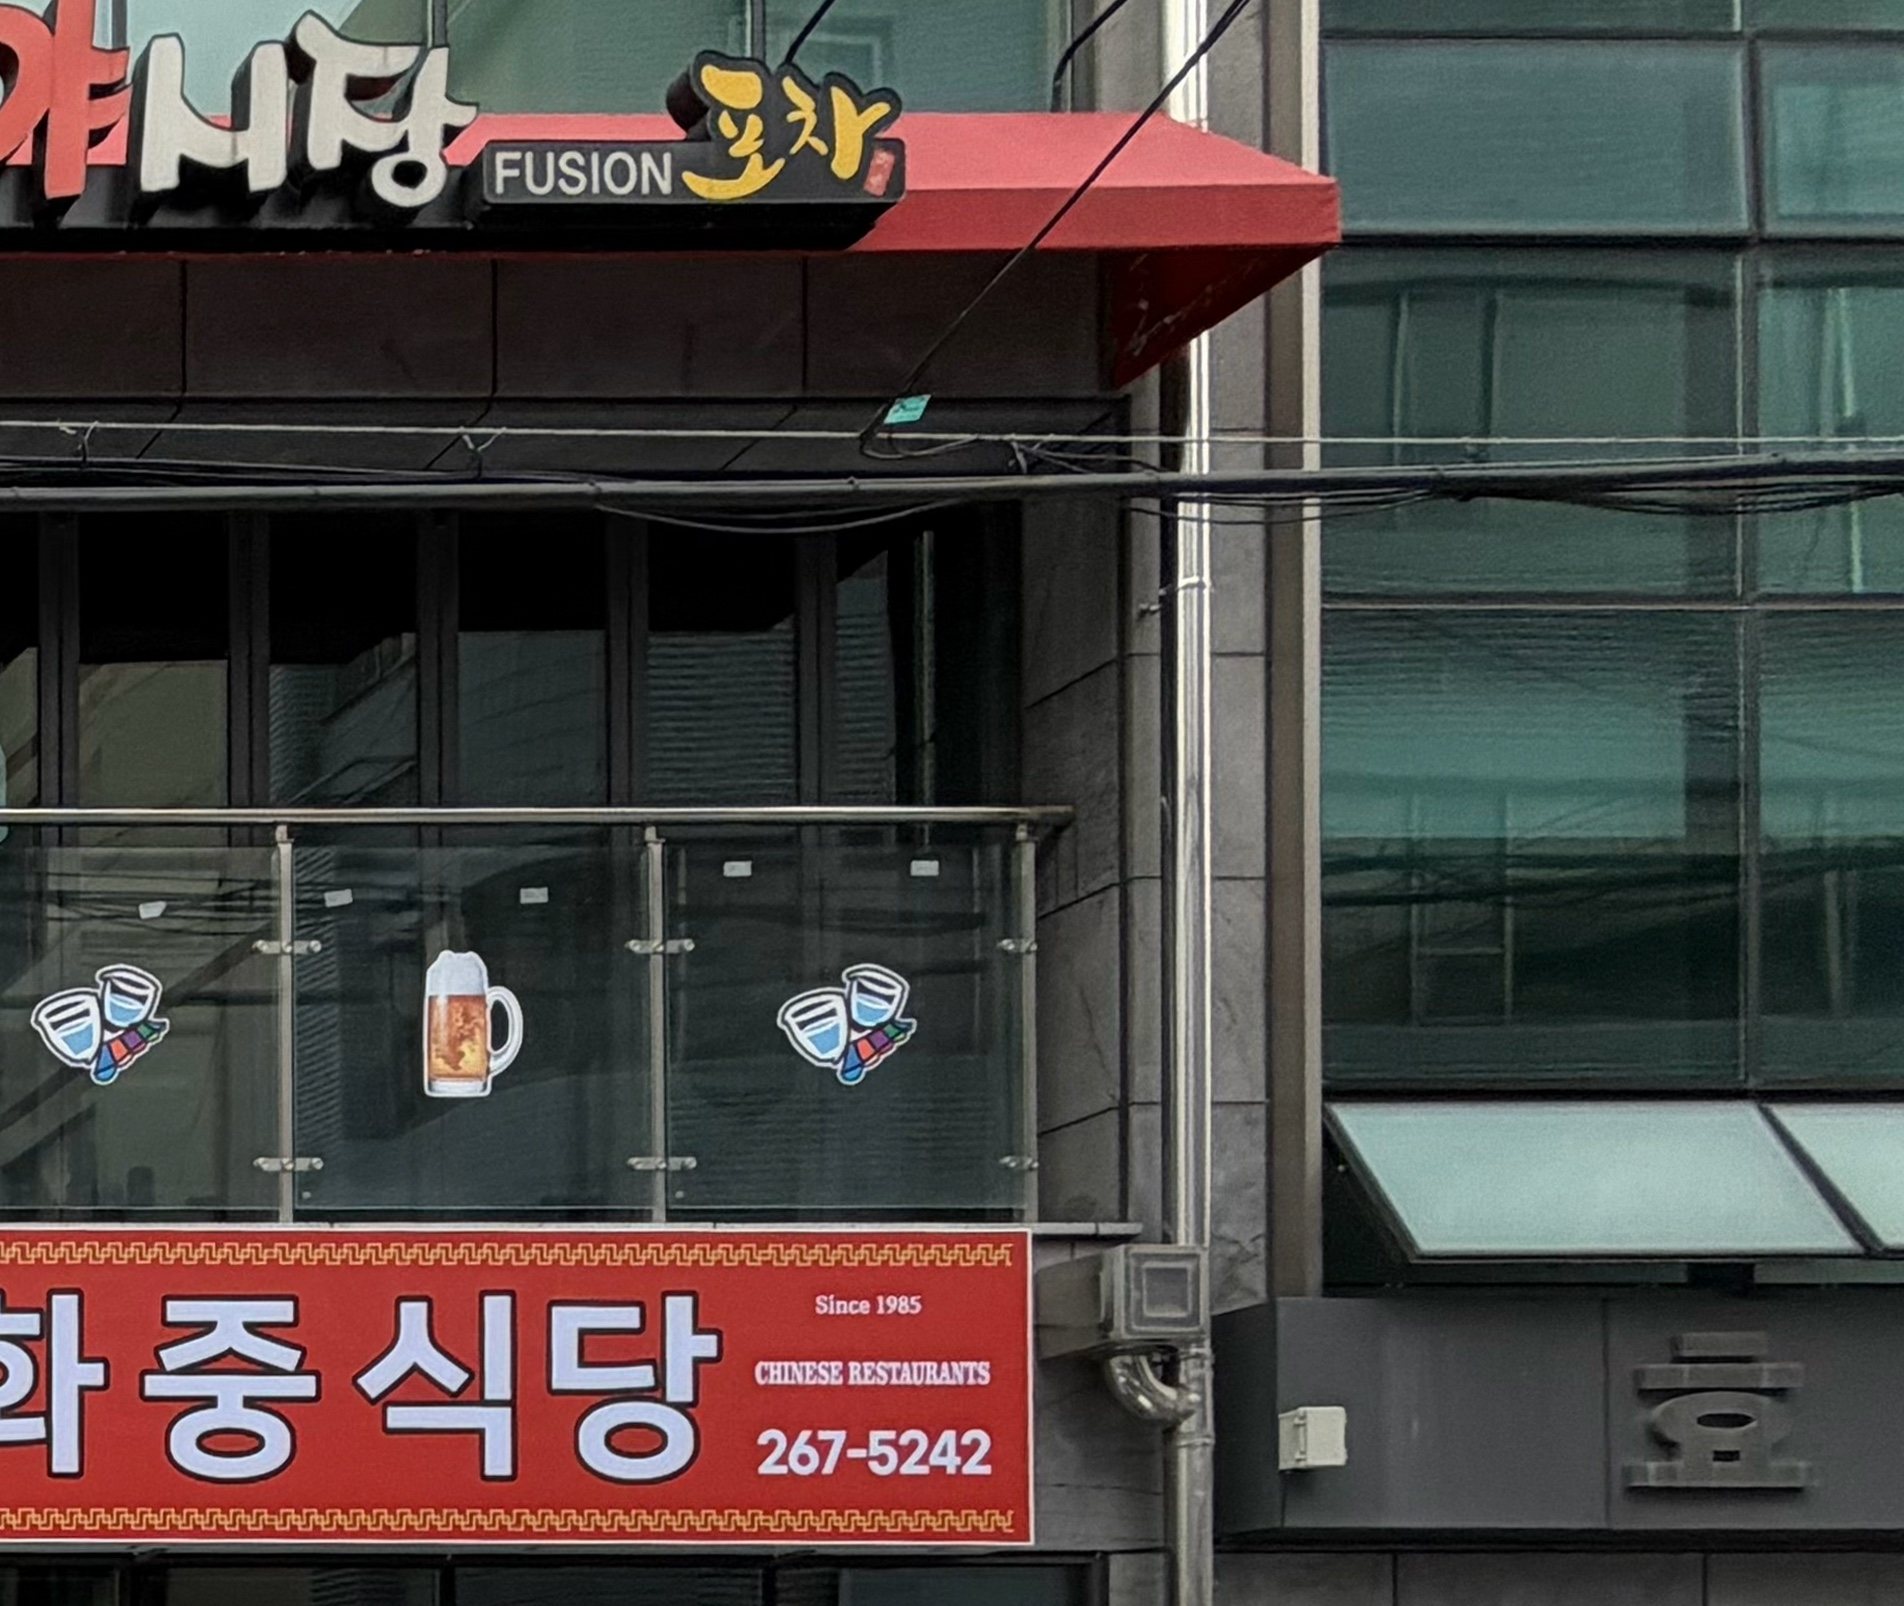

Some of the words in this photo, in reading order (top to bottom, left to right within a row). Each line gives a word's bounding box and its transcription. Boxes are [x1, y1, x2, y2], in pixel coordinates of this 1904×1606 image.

[494, 149, 673, 197] FUSION
[681, 64, 890, 200] 포차
[814, 1294, 871, 1315] Since
[876, 1294, 923, 1315] 1985
[754, 1360, 844, 1386] CHINESE
[847, 1360, 991, 1386] RESTAURANTS
[757, 1428, 993, 1476] 267-5242
